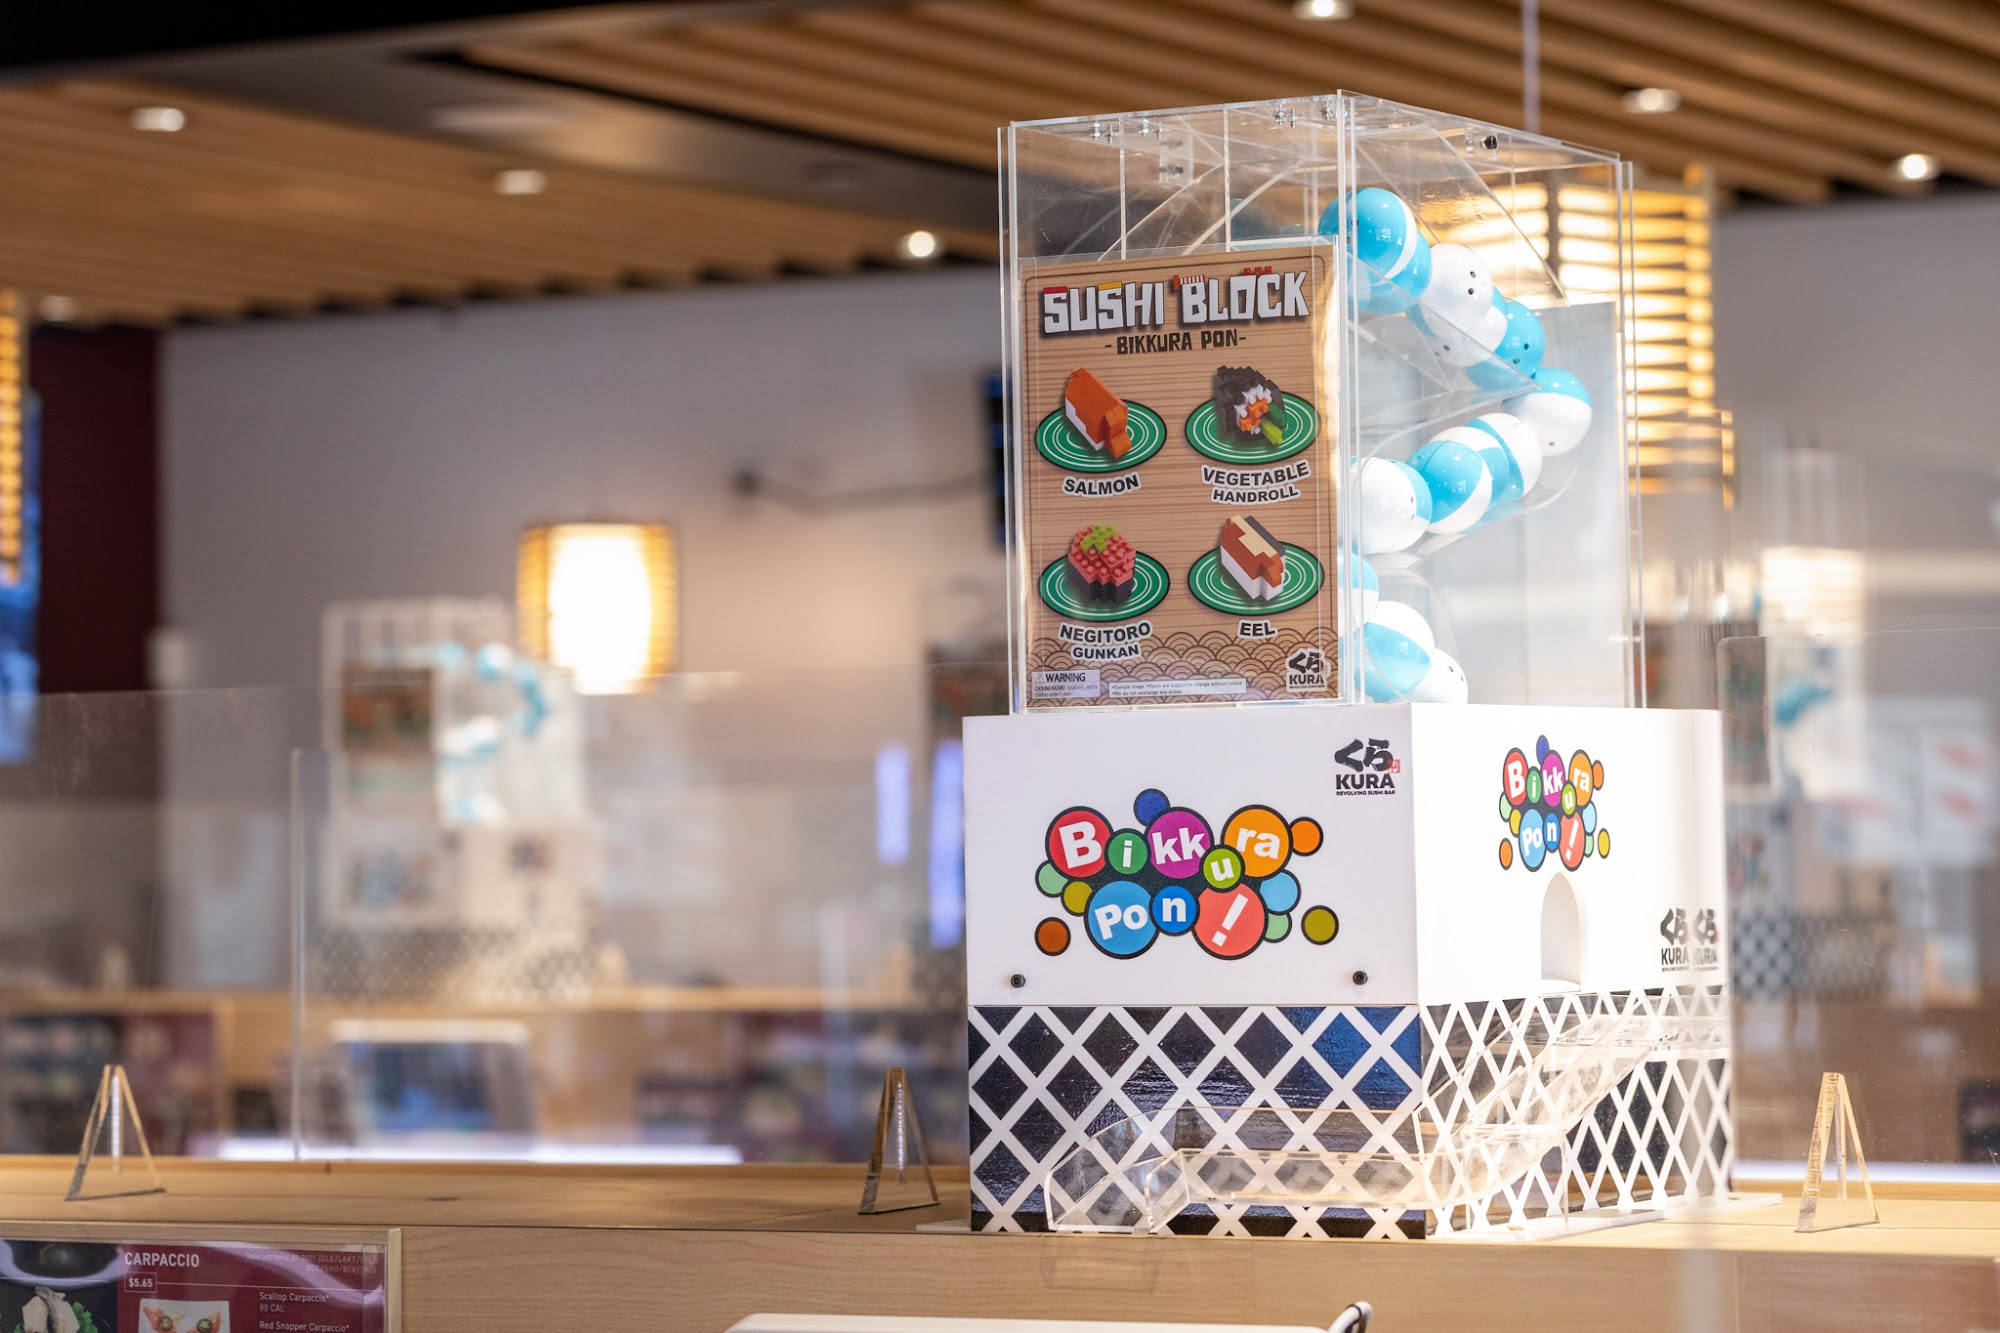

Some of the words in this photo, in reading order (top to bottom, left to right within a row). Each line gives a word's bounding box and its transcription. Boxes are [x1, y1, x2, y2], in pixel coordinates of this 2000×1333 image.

[1043, 281, 1165, 334] SUSHI
[1180, 271, 1311, 324] BLOCK
[1203, 462, 1309, 486] VEGETABLE
[1064, 474, 1139, 495] SALMON
[1213, 486, 1299, 503] HANDROLL
[1060, 622, 1151, 643] NEGITORO
[1239, 622, 1276, 637] EEL
[1072, 644, 1139, 660] GUNKAN
[1045, 672, 1086, 683] WARNING
[1289, 674, 1325, 685] KURA
[1334, 738, 1394, 772] くら
[1336, 774, 1396, 790] KURA
[1661, 947, 1690, 965] KURA
[124, 1252, 200, 1268] CARPACCIO
[128, 1277, 153, 1288] $5.65
[259, 1292, 287, 1303] Scallop
[259, 1303, 269, 1312] 80
[270, 1303, 285, 1313] CAL
[259, 1320, 274, 1330] Red
[275, 1321, 307, 1332] Snapper
